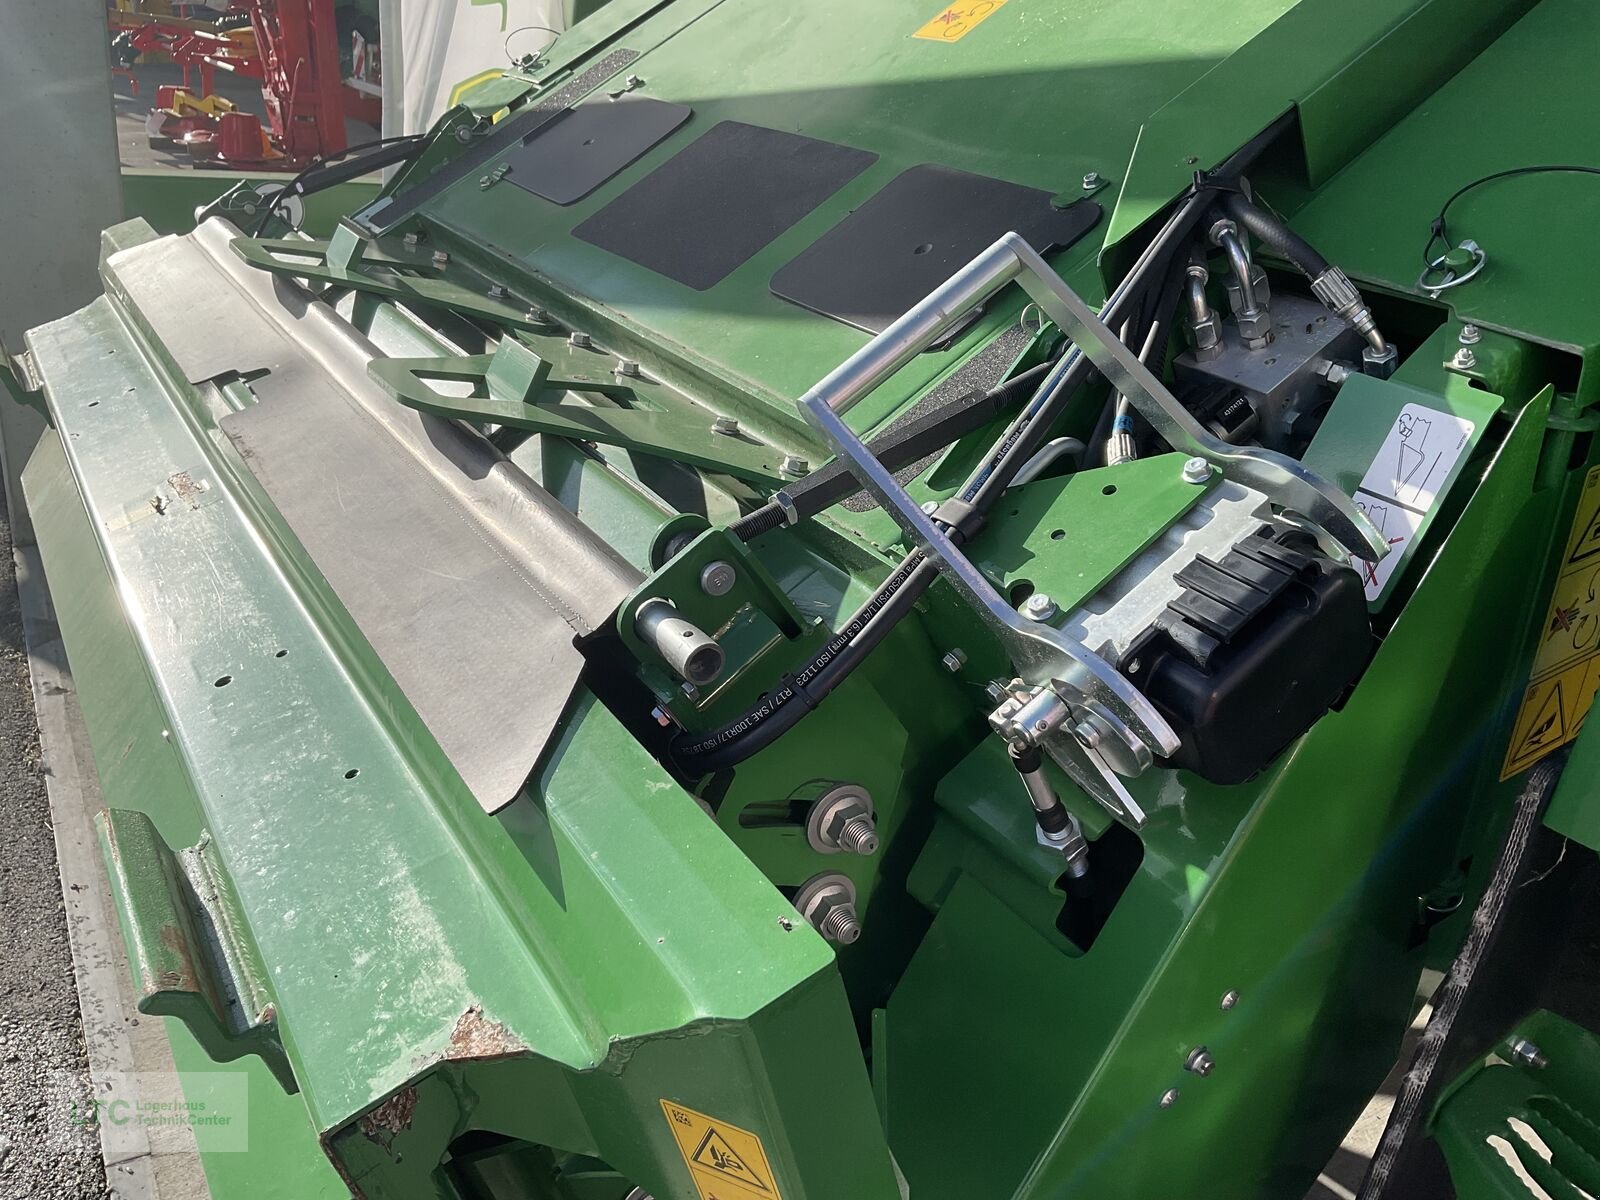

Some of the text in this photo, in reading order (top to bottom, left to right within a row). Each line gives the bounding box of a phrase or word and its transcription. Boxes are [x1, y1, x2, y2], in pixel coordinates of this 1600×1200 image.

[815, 651, 832, 668] ISO
[775, 687, 793, 705] R17
[751, 705, 770, 722] SAE
[703, 738, 718, 750] ISO
